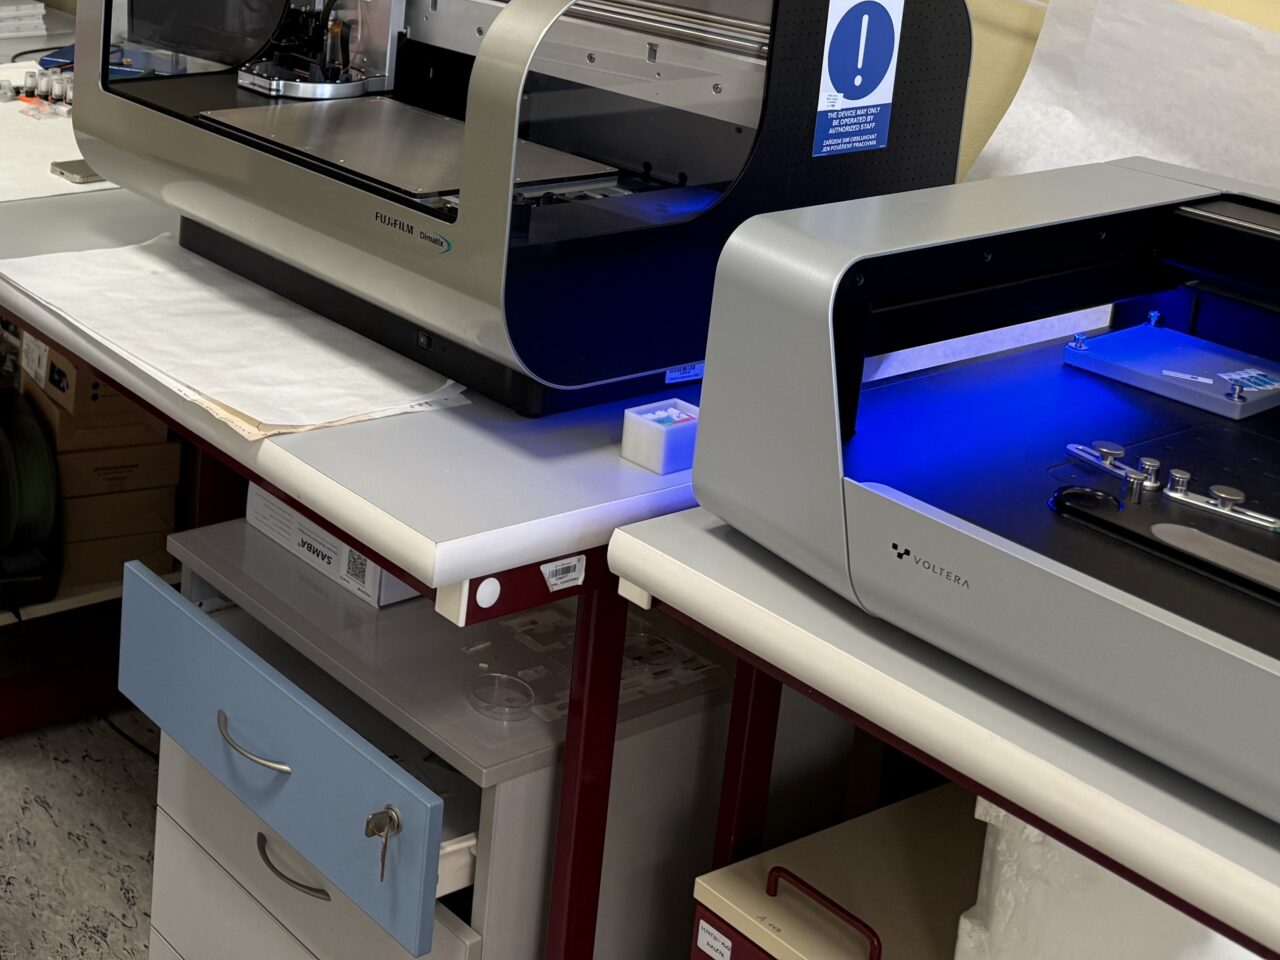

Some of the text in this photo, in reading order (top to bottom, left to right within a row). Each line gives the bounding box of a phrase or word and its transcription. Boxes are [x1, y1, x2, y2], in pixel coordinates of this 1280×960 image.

[838, 109, 856, 117] DEVICE
[840, 116, 866, 125] OPERATED
[829, 125, 860, 134] AUTHORIZED
[420, 231, 444, 247] Dimatix
[300, 538, 333, 565] SAMBA
[914, 555, 970, 590] VOLTERA
